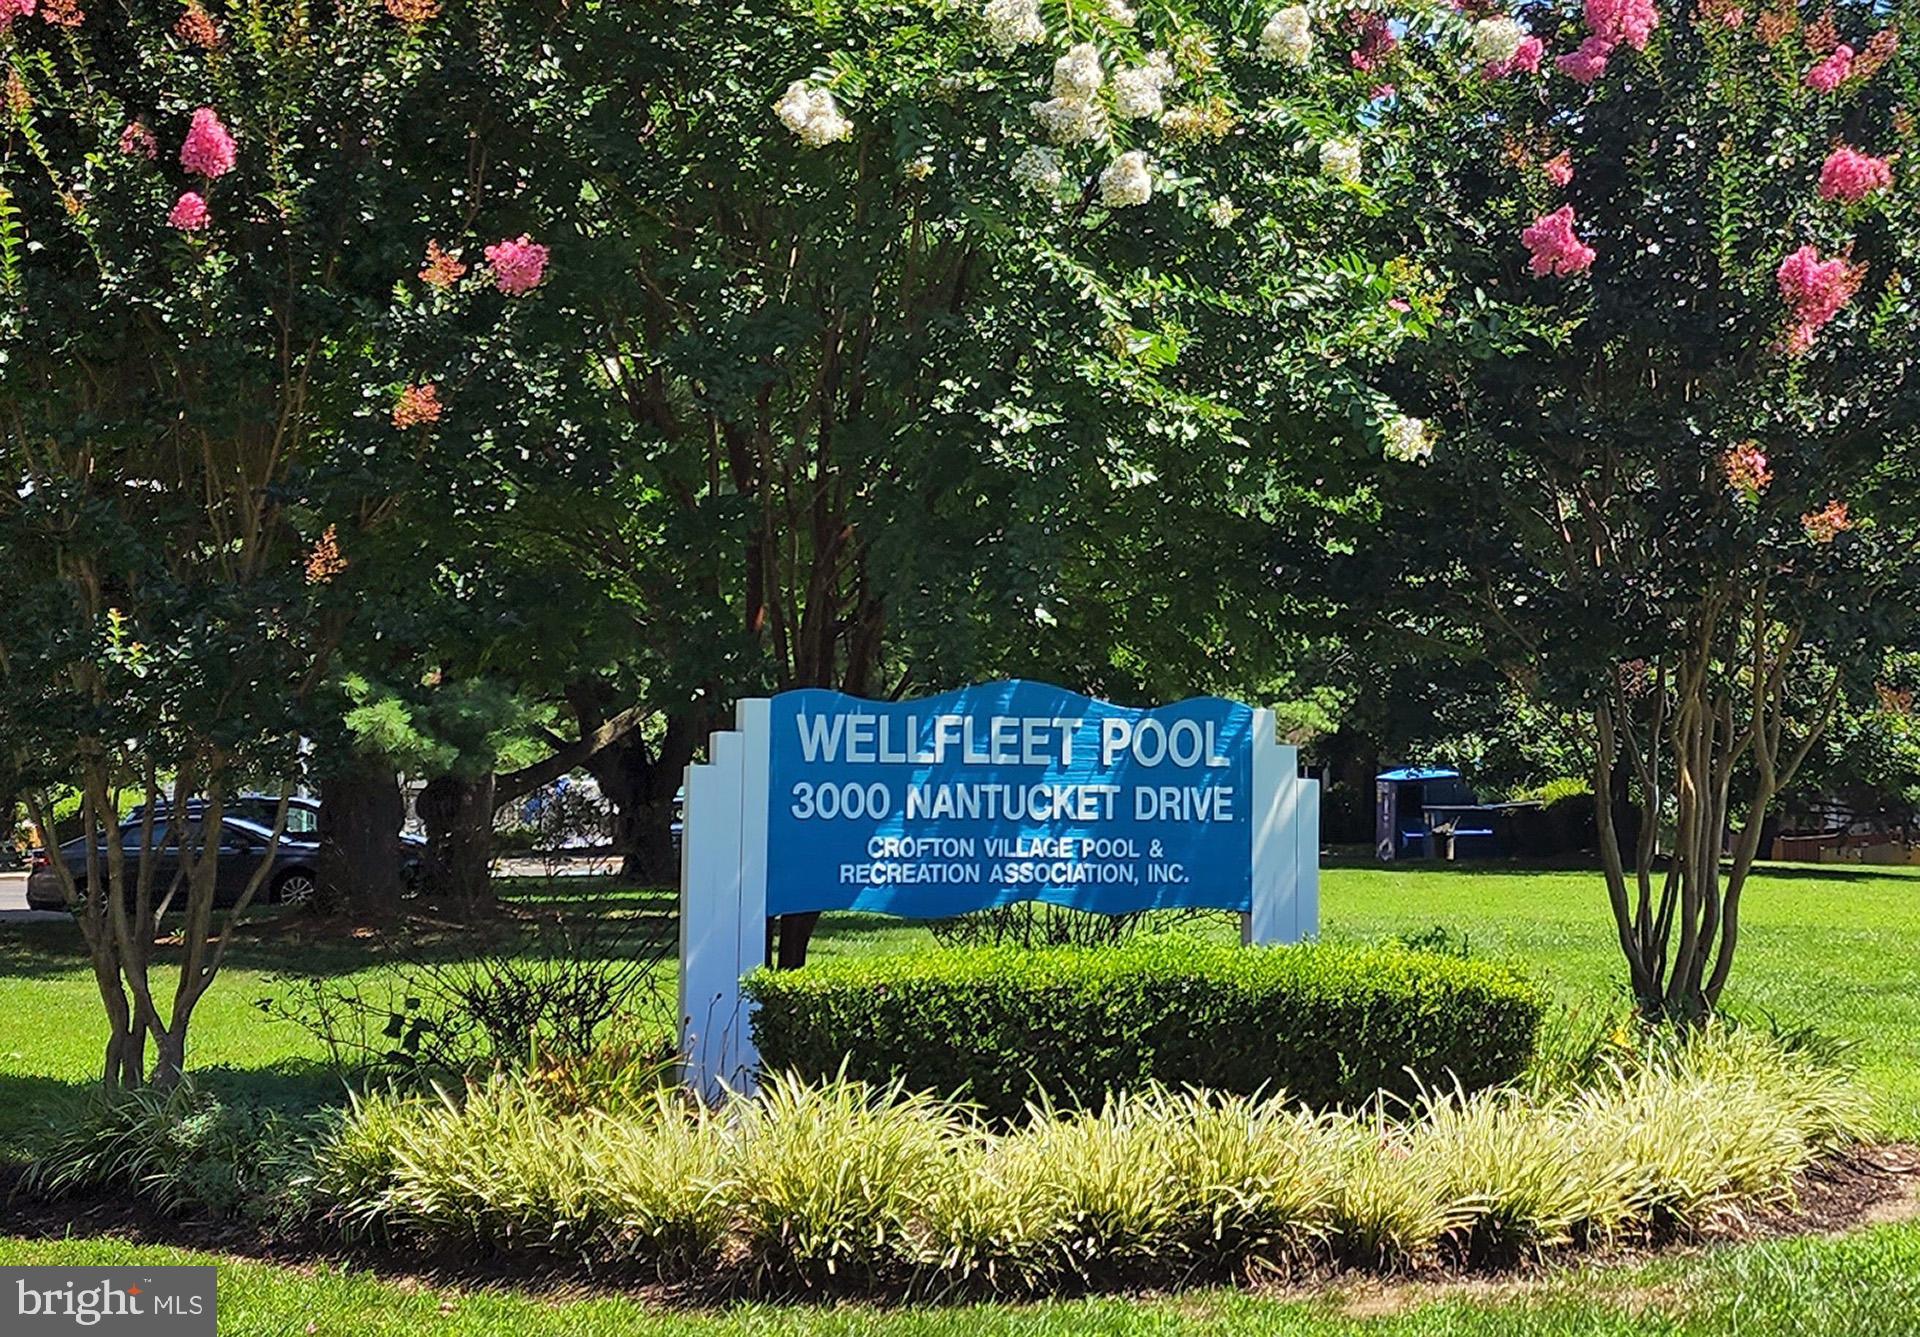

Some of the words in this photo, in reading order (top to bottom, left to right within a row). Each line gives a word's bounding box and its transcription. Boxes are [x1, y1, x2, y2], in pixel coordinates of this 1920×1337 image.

[796, 713, 1082, 766] WELLFLEET
[1102, 717, 1230, 768] POOL
[791, 782, 890, 820] 3000
[906, 783, 1125, 821] NANTUCKET
[1134, 786, 1233, 821] DRIVE
[867, 836, 975, 858] CROFTON
[984, 836, 1073, 858] VILLAGE
[1082, 837, 1140, 858] POOL
[1148, 838, 1164, 858] &
[840, 861, 980, 884] RECREATION
[989, 861, 1139, 886] ASSOCIATION,
[1147, 863, 1190, 884] INC.
